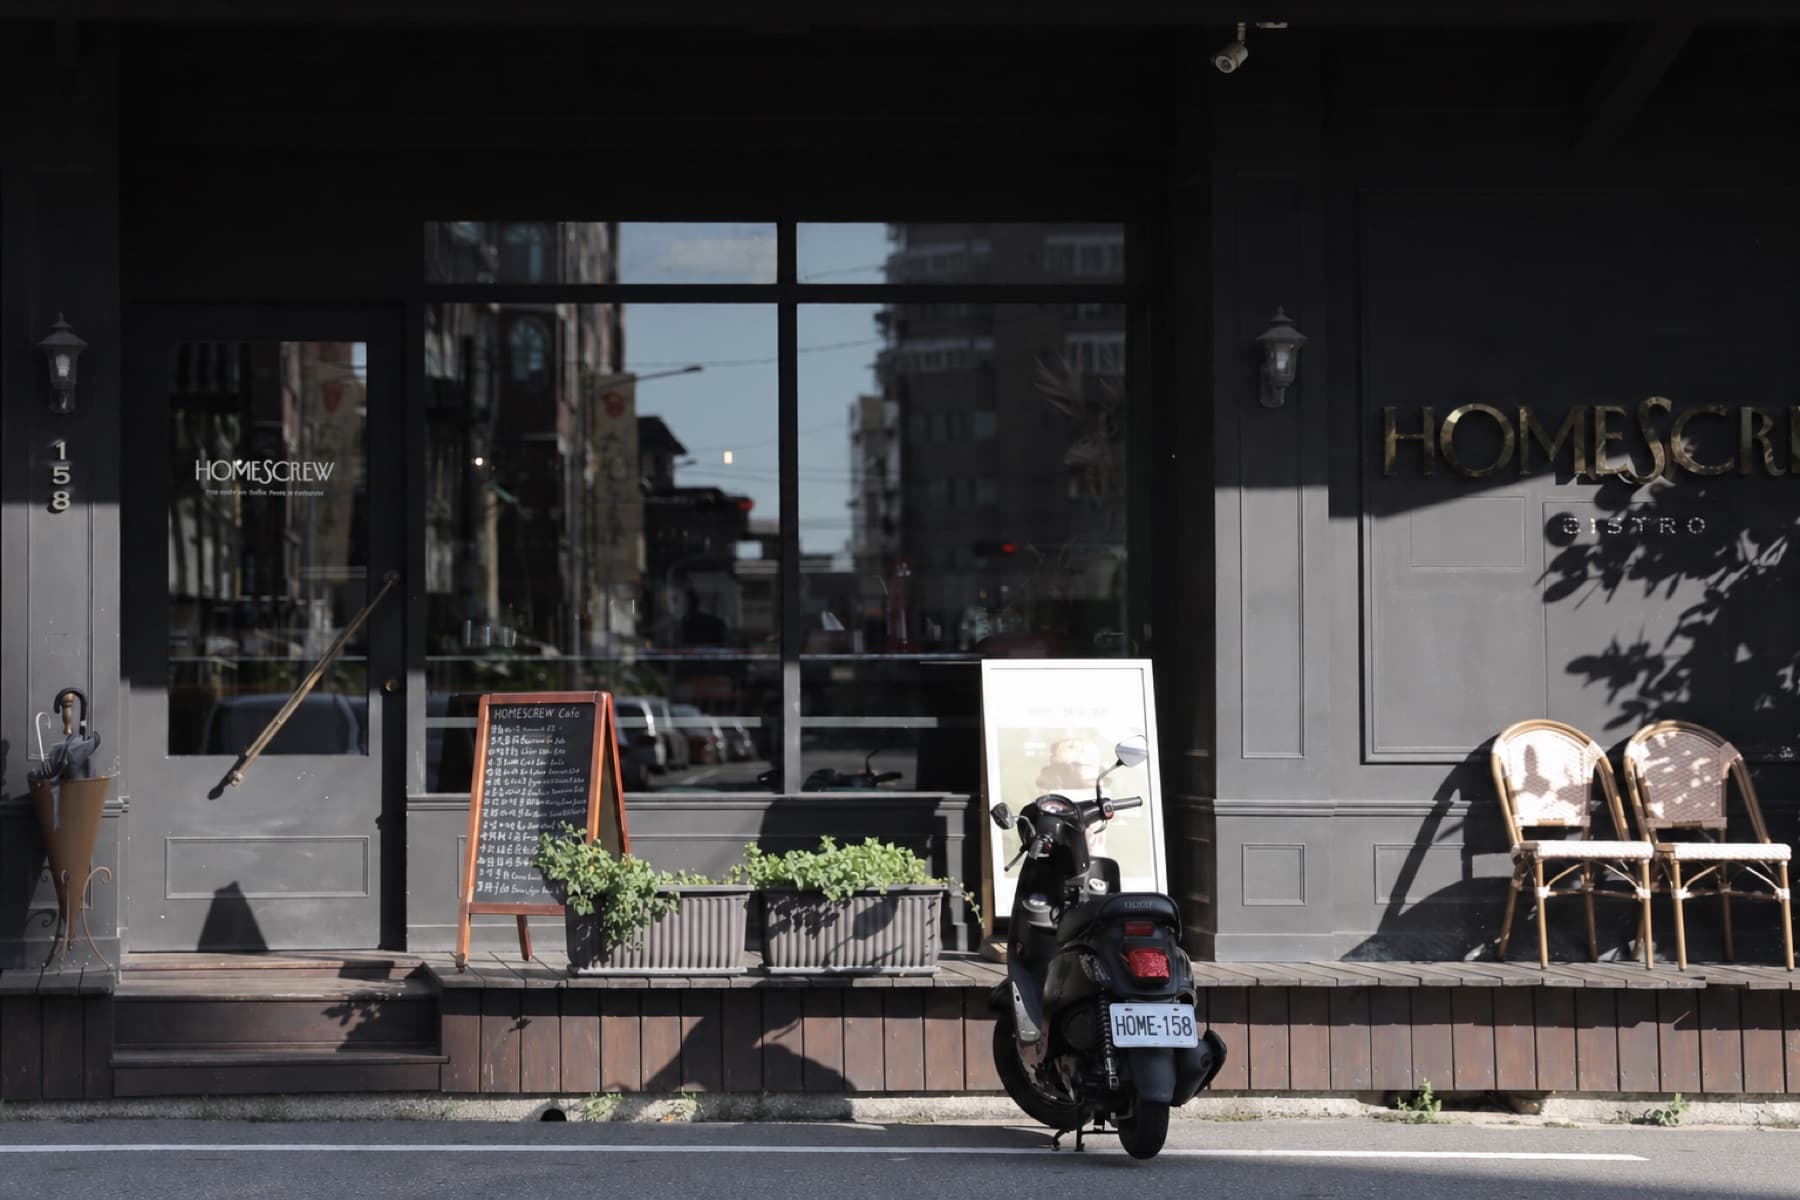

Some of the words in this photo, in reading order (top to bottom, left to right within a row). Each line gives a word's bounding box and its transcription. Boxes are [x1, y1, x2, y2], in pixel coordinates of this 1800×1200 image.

[52, 441, 71, 511] 158
[195, 459, 335, 485] HOMESCREW
[1562, 517, 1706, 534] BISTRO
[494, 707, 554, 719] HOMESCREW
[558, 707, 581, 719] Cafe
[1114, 1014, 1193, 1037] HOME-158
